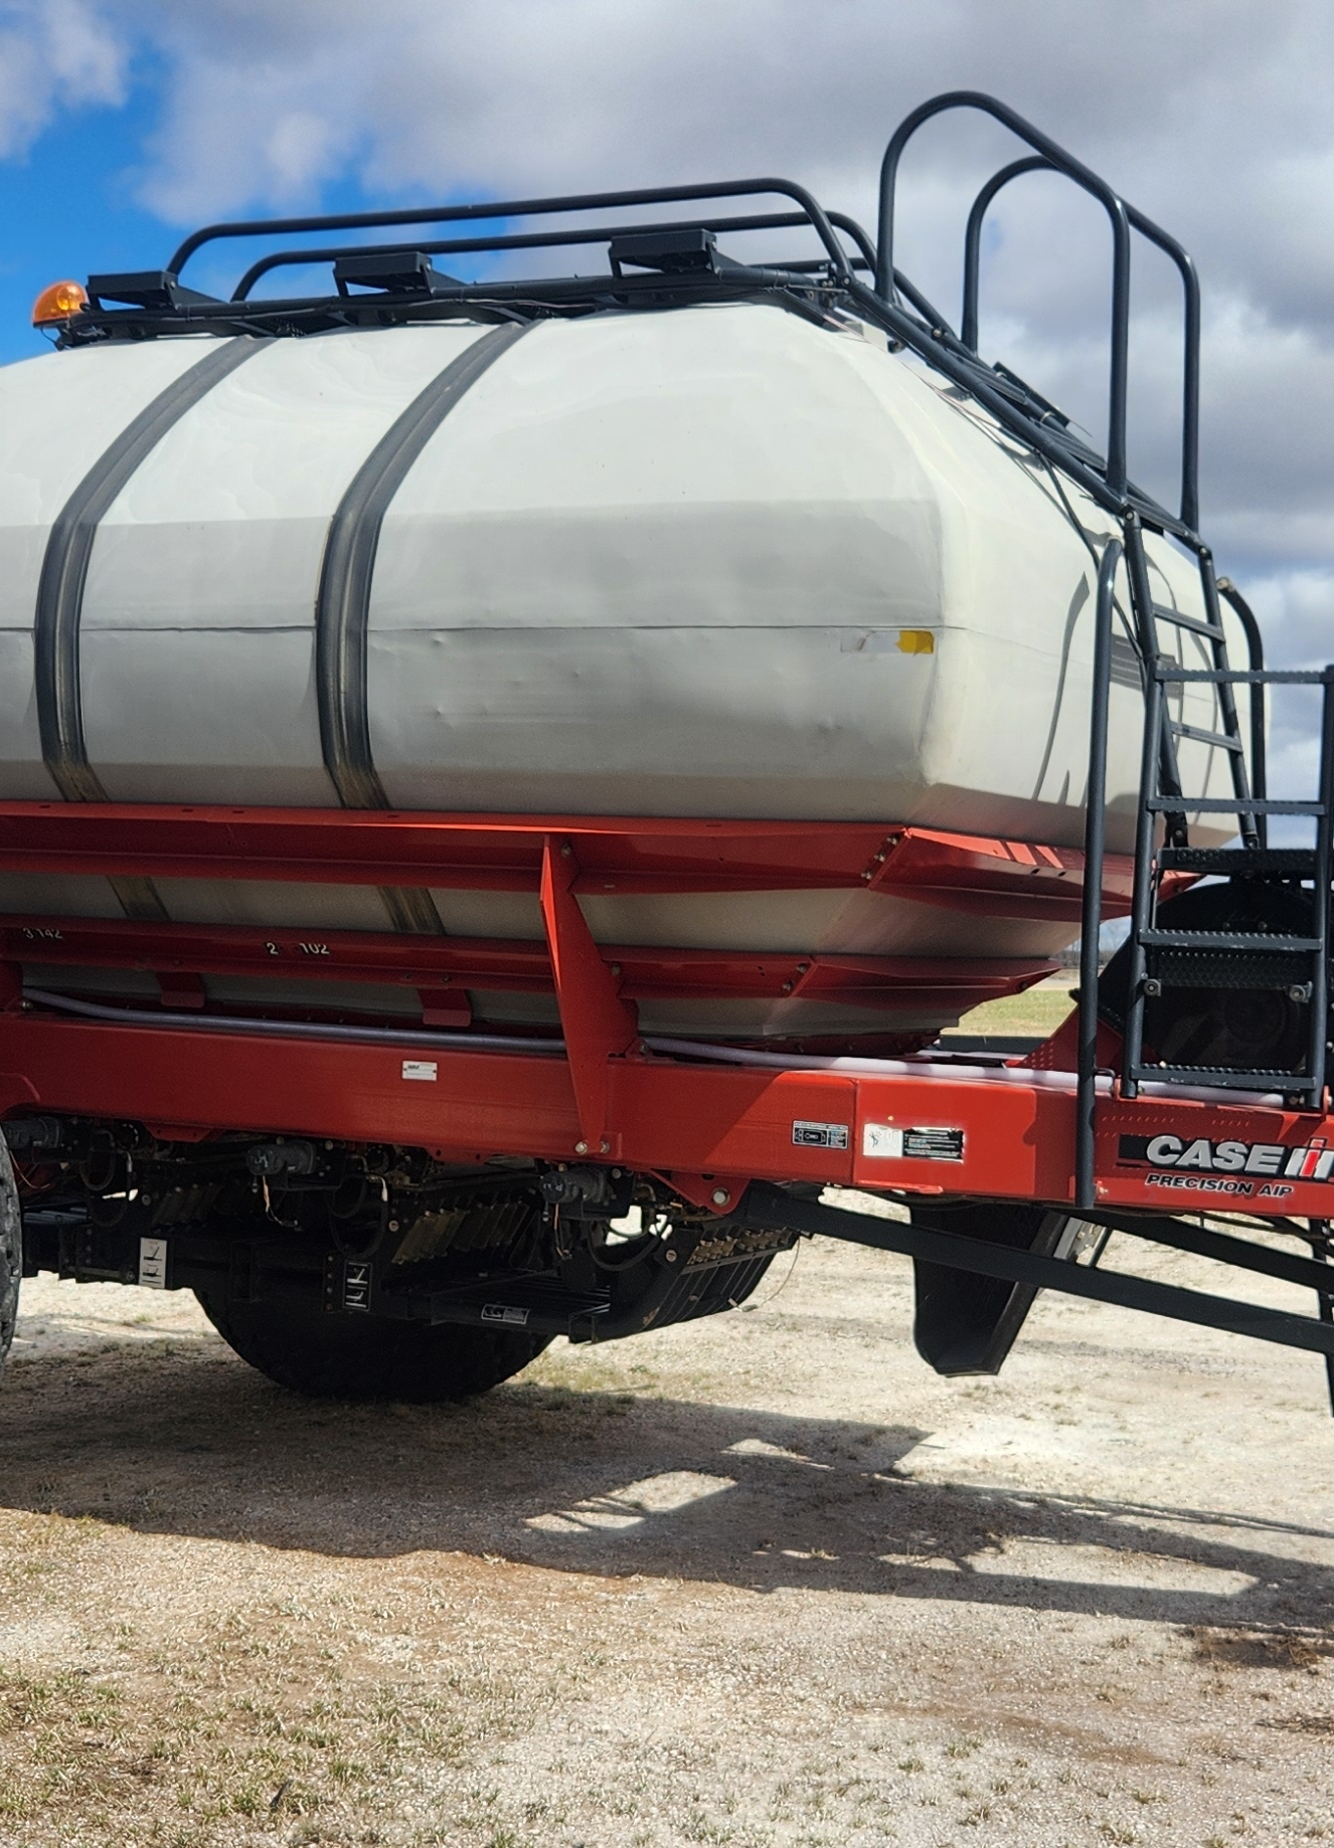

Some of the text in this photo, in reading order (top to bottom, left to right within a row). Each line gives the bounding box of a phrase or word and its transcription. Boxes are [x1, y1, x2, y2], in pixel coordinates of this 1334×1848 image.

[266, 942, 279, 955] 2
[1146, 1135, 1285, 1174] CASE
[1145, 1173, 1253, 1195] PRECISION
